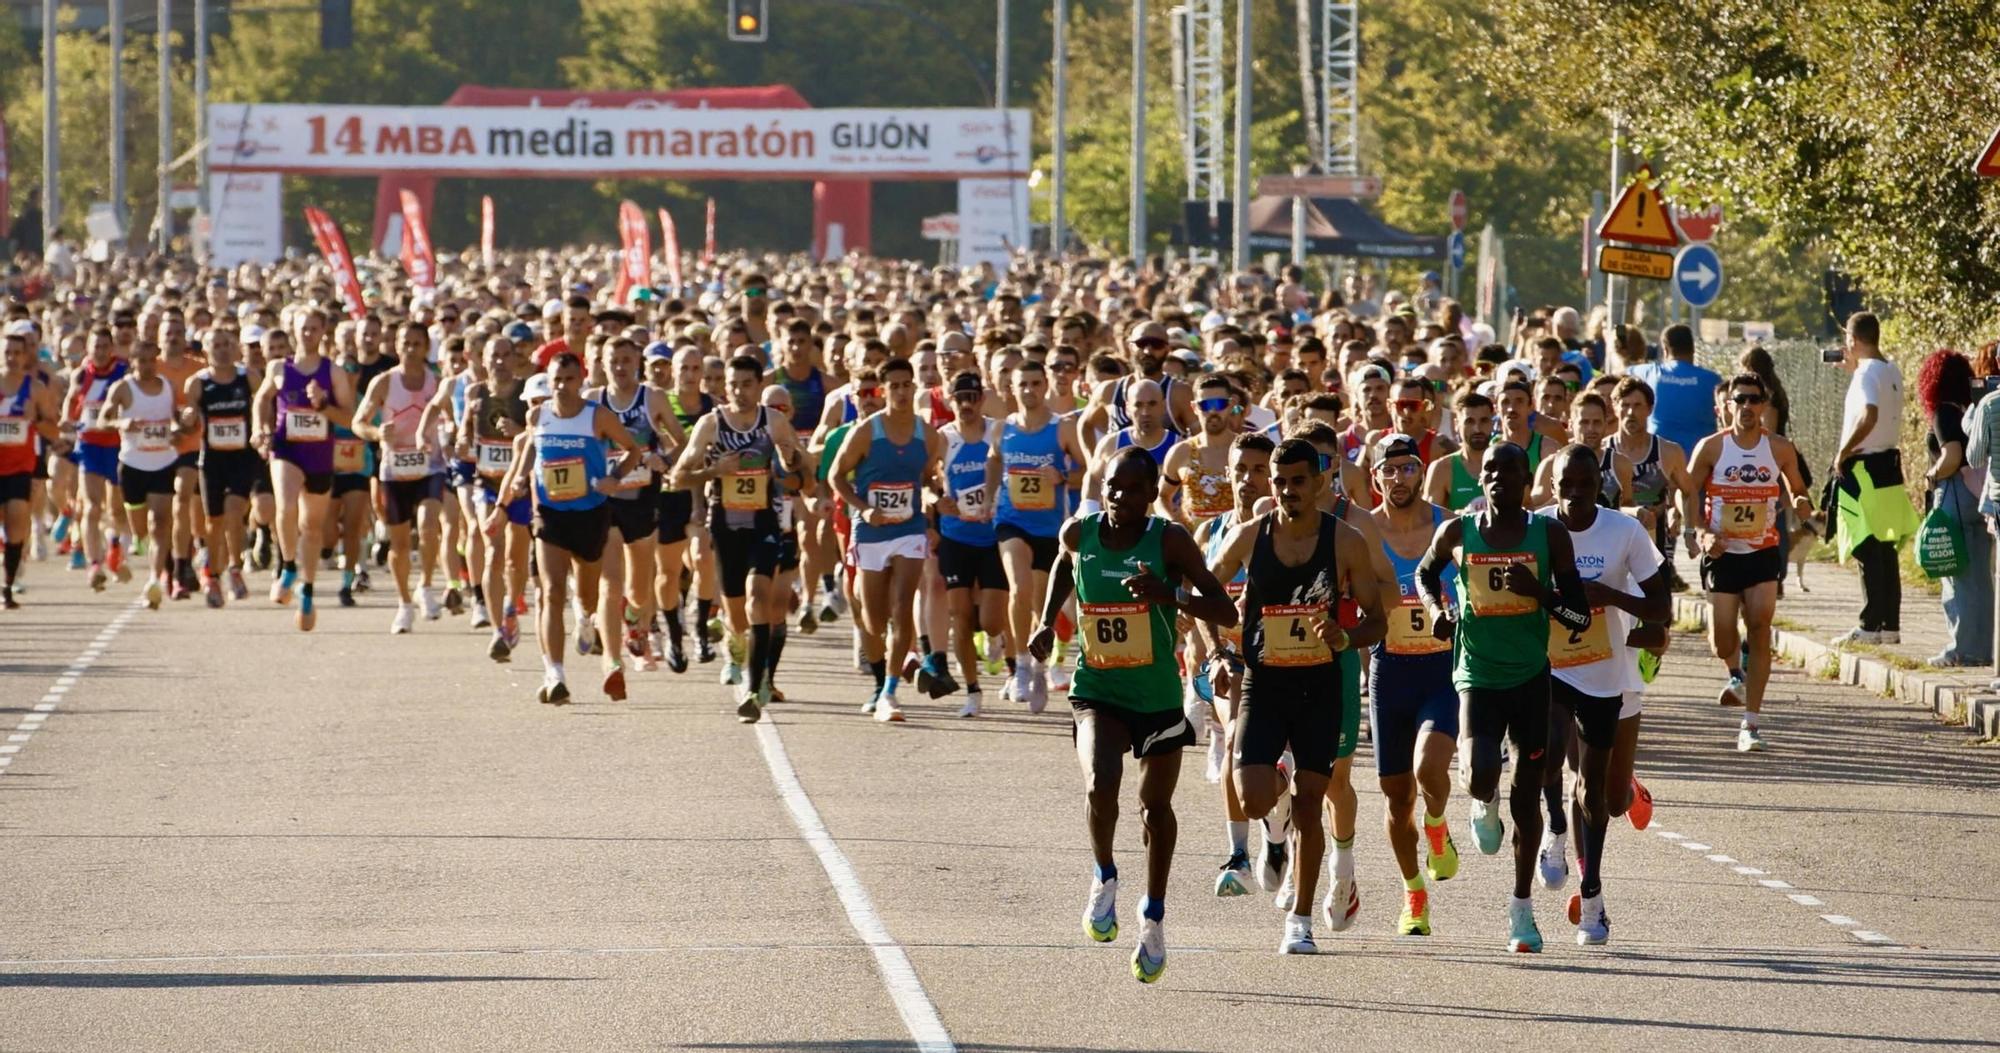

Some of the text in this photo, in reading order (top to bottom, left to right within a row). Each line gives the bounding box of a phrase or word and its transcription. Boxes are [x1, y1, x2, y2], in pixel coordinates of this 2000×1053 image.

[307, 115, 929, 157] 14 MBA media maratón GIJÓN
[1624, 252, 1651, 263] SALIDA
[294, 414, 321, 428] 1154
[395, 453, 425, 467] 2559
[553, 468, 569, 485] 17
[736, 478, 756, 495] 29
[1020, 477, 1041, 494] 23
[873, 491, 908, 509] 1524
[1734, 505, 1755, 523] 24
[1576, 554, 1604, 564] ATÓN
[1411, 608, 1424, 632] 5
[1097, 617, 1128, 644] 68
[1290, 618, 1306, 642] 4
